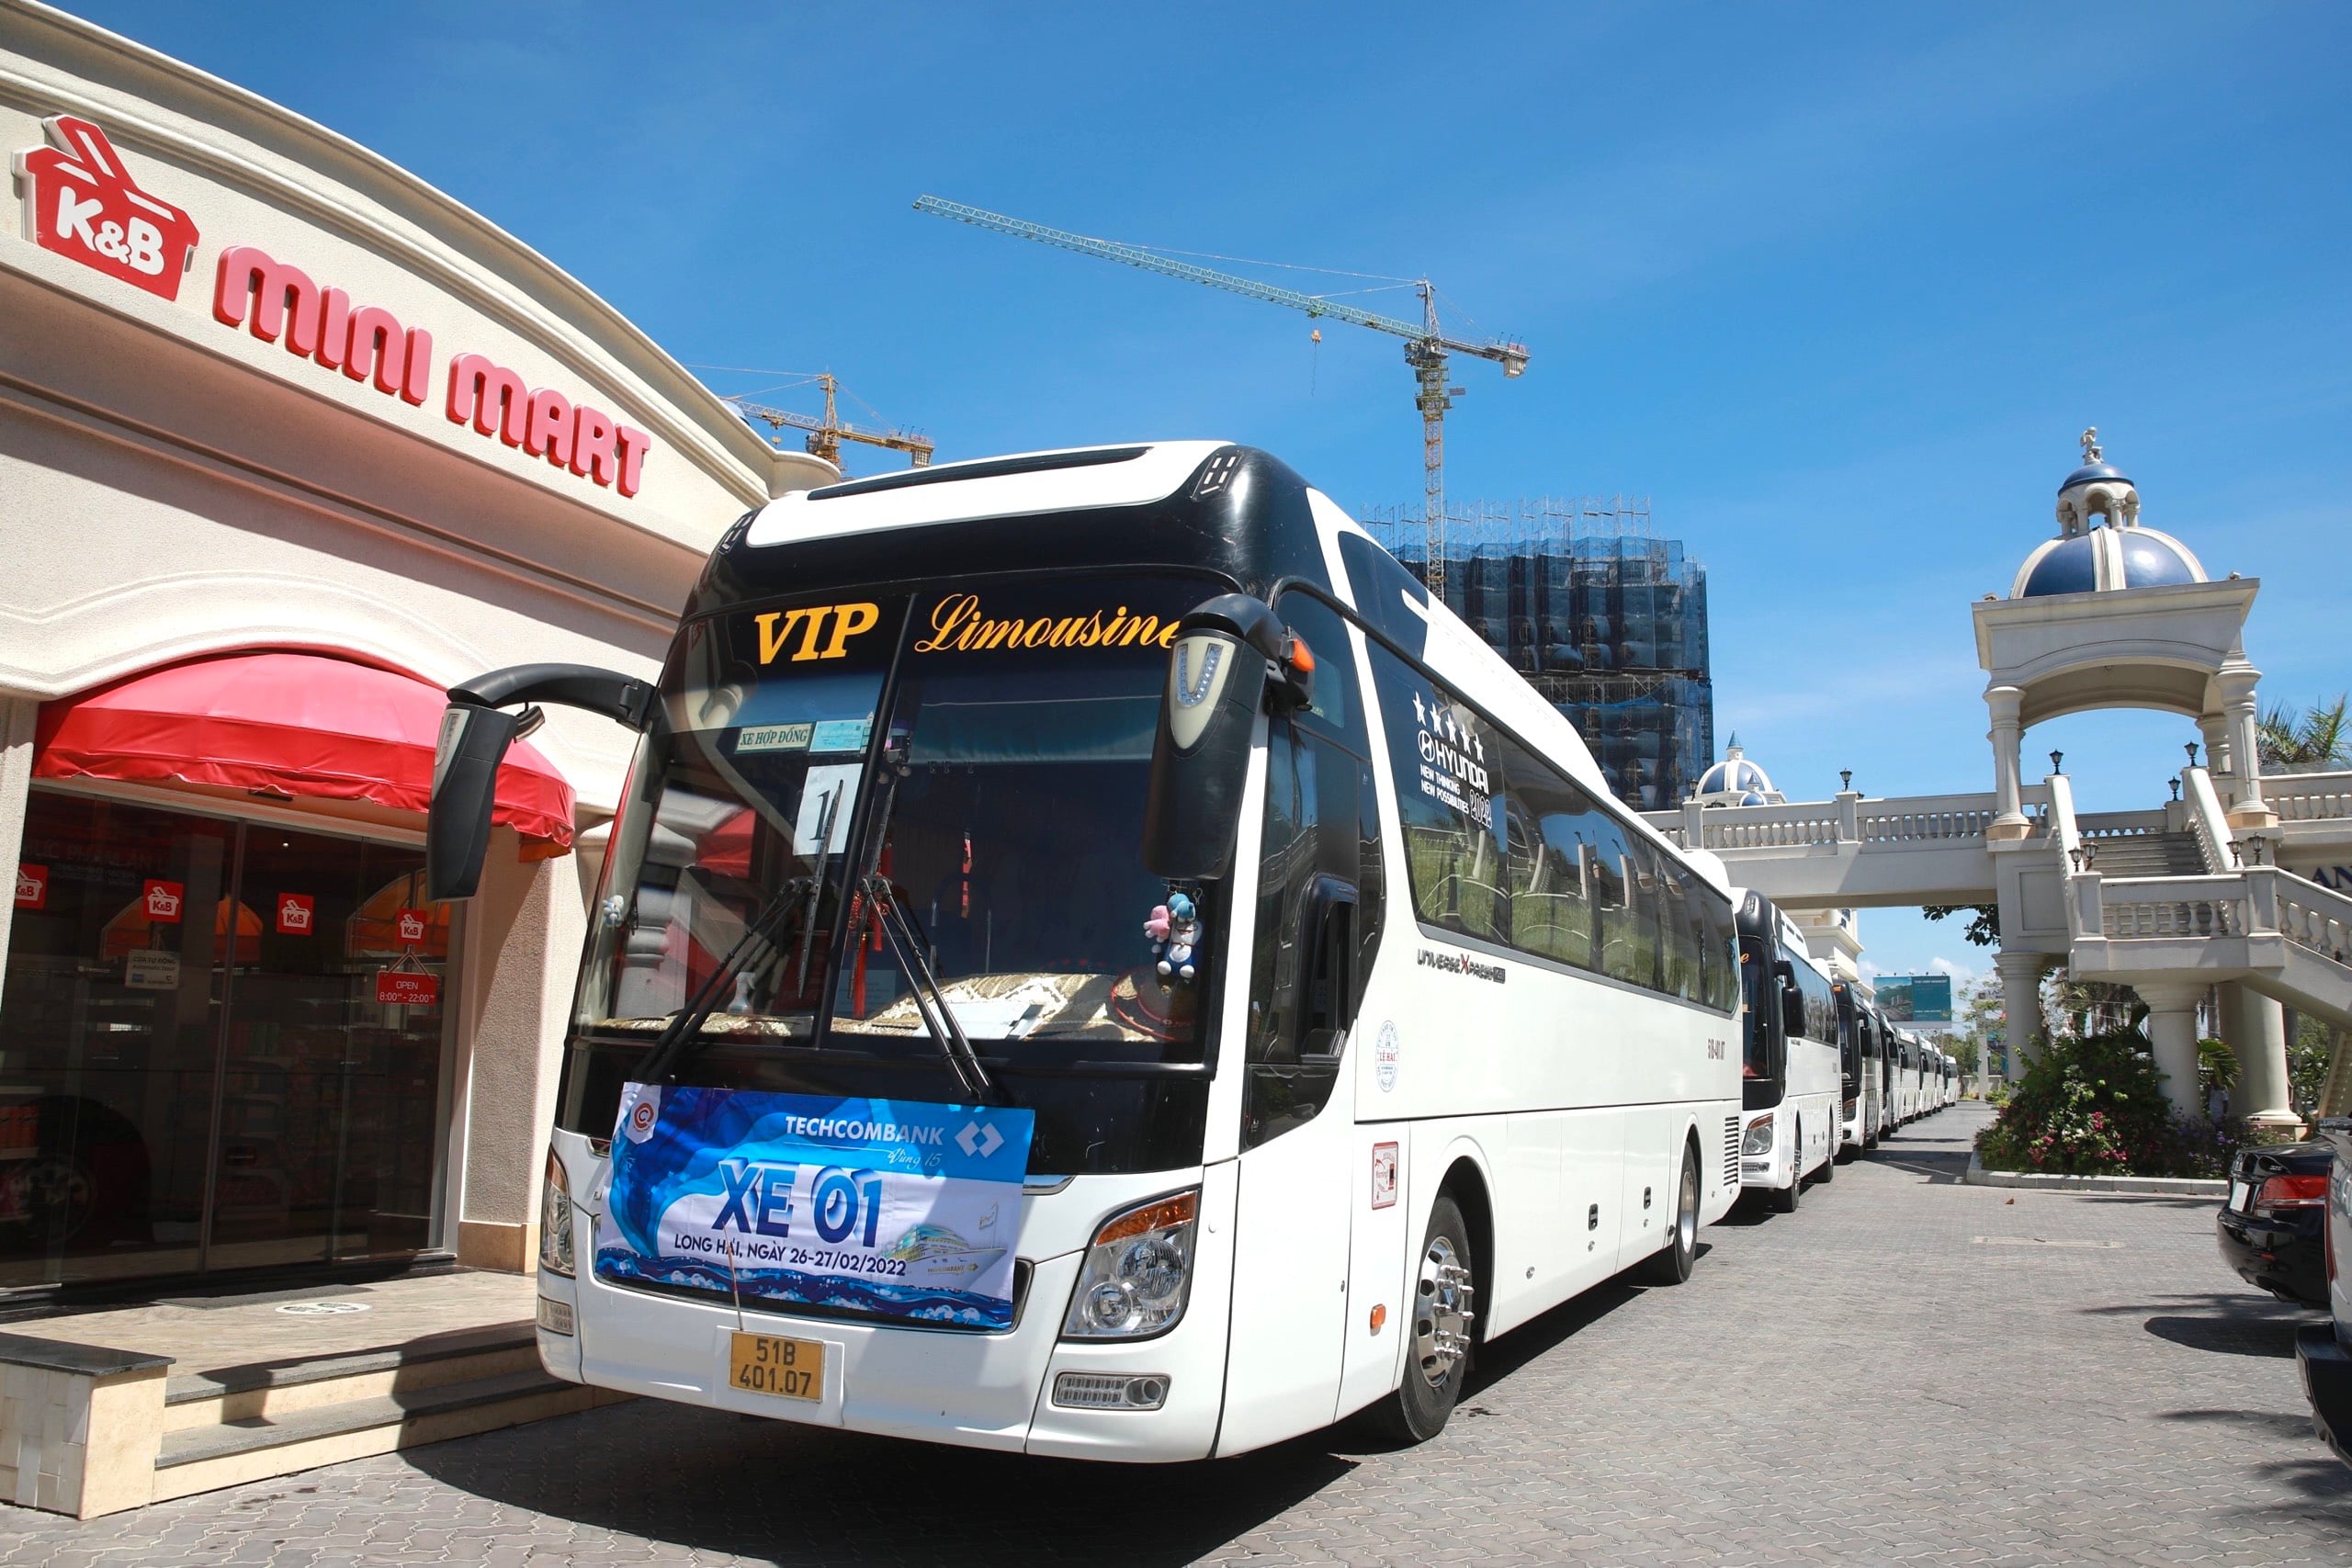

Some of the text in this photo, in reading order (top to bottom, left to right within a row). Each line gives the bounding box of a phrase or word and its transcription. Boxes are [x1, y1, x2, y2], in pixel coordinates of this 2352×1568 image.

[55, 185, 165, 276] K&B
[212, 245, 650, 499] MINI MART
[754, 602, 878, 665] VIP
[741, 733, 753, 745] XE
[755, 730, 777, 746] HỢP
[778, 727, 808, 743] ĐỒNG
[1419, 763, 1435, 782] NEW
[1435, 739, 1489, 795] HYUNDAI
[1420, 779, 1435, 797] NEW
[1470, 789, 1492, 829] 2022
[153, 900, 173, 912] K&B
[286, 913, 304, 925] K&B
[403, 926, 419, 936] K&B
[396, 981, 419, 989] OPEN
[786, 1116, 945, 1145] TECHCOMBANK
[888, 1147, 943, 1170] Vùng 15
[712, 1158, 883, 1248] XE 01
[674, 1234, 713, 1253] LONG
[747, 1241, 786, 1262] NGÀY
[789, 1247, 906, 1277] 26-27/02/2022
[756, 1338, 796, 1366] 51B
[740, 1364, 811, 1395] 401.07
